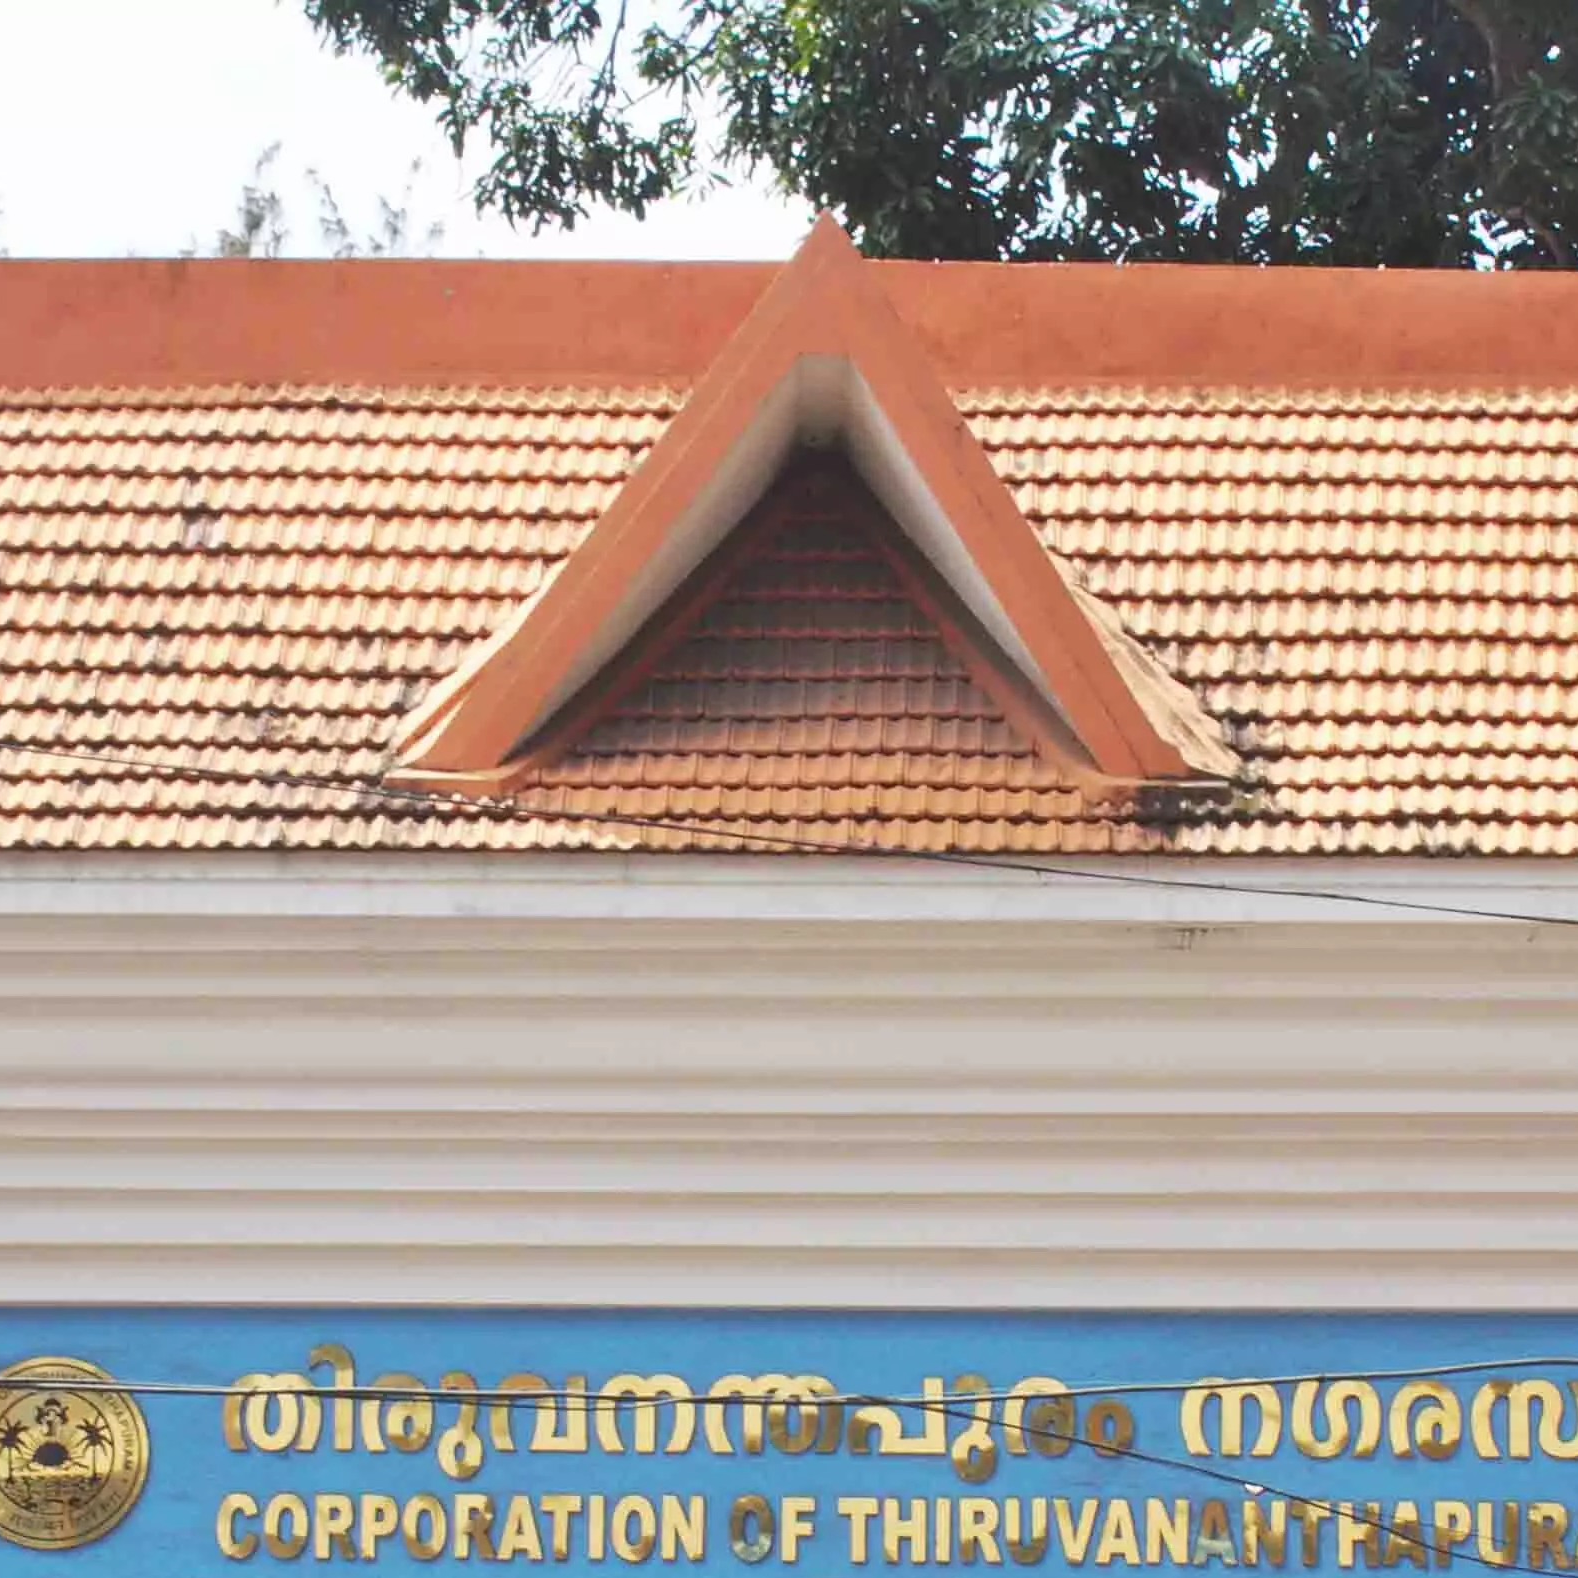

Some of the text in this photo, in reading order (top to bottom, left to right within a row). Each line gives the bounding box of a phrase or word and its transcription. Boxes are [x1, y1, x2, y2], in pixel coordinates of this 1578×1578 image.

[224, 1342, 1132, 1482] തിരുവനന്തപുരം
[215, 1493, 706, 1563] CORPORATION
[729, 1495, 817, 1564] OF
